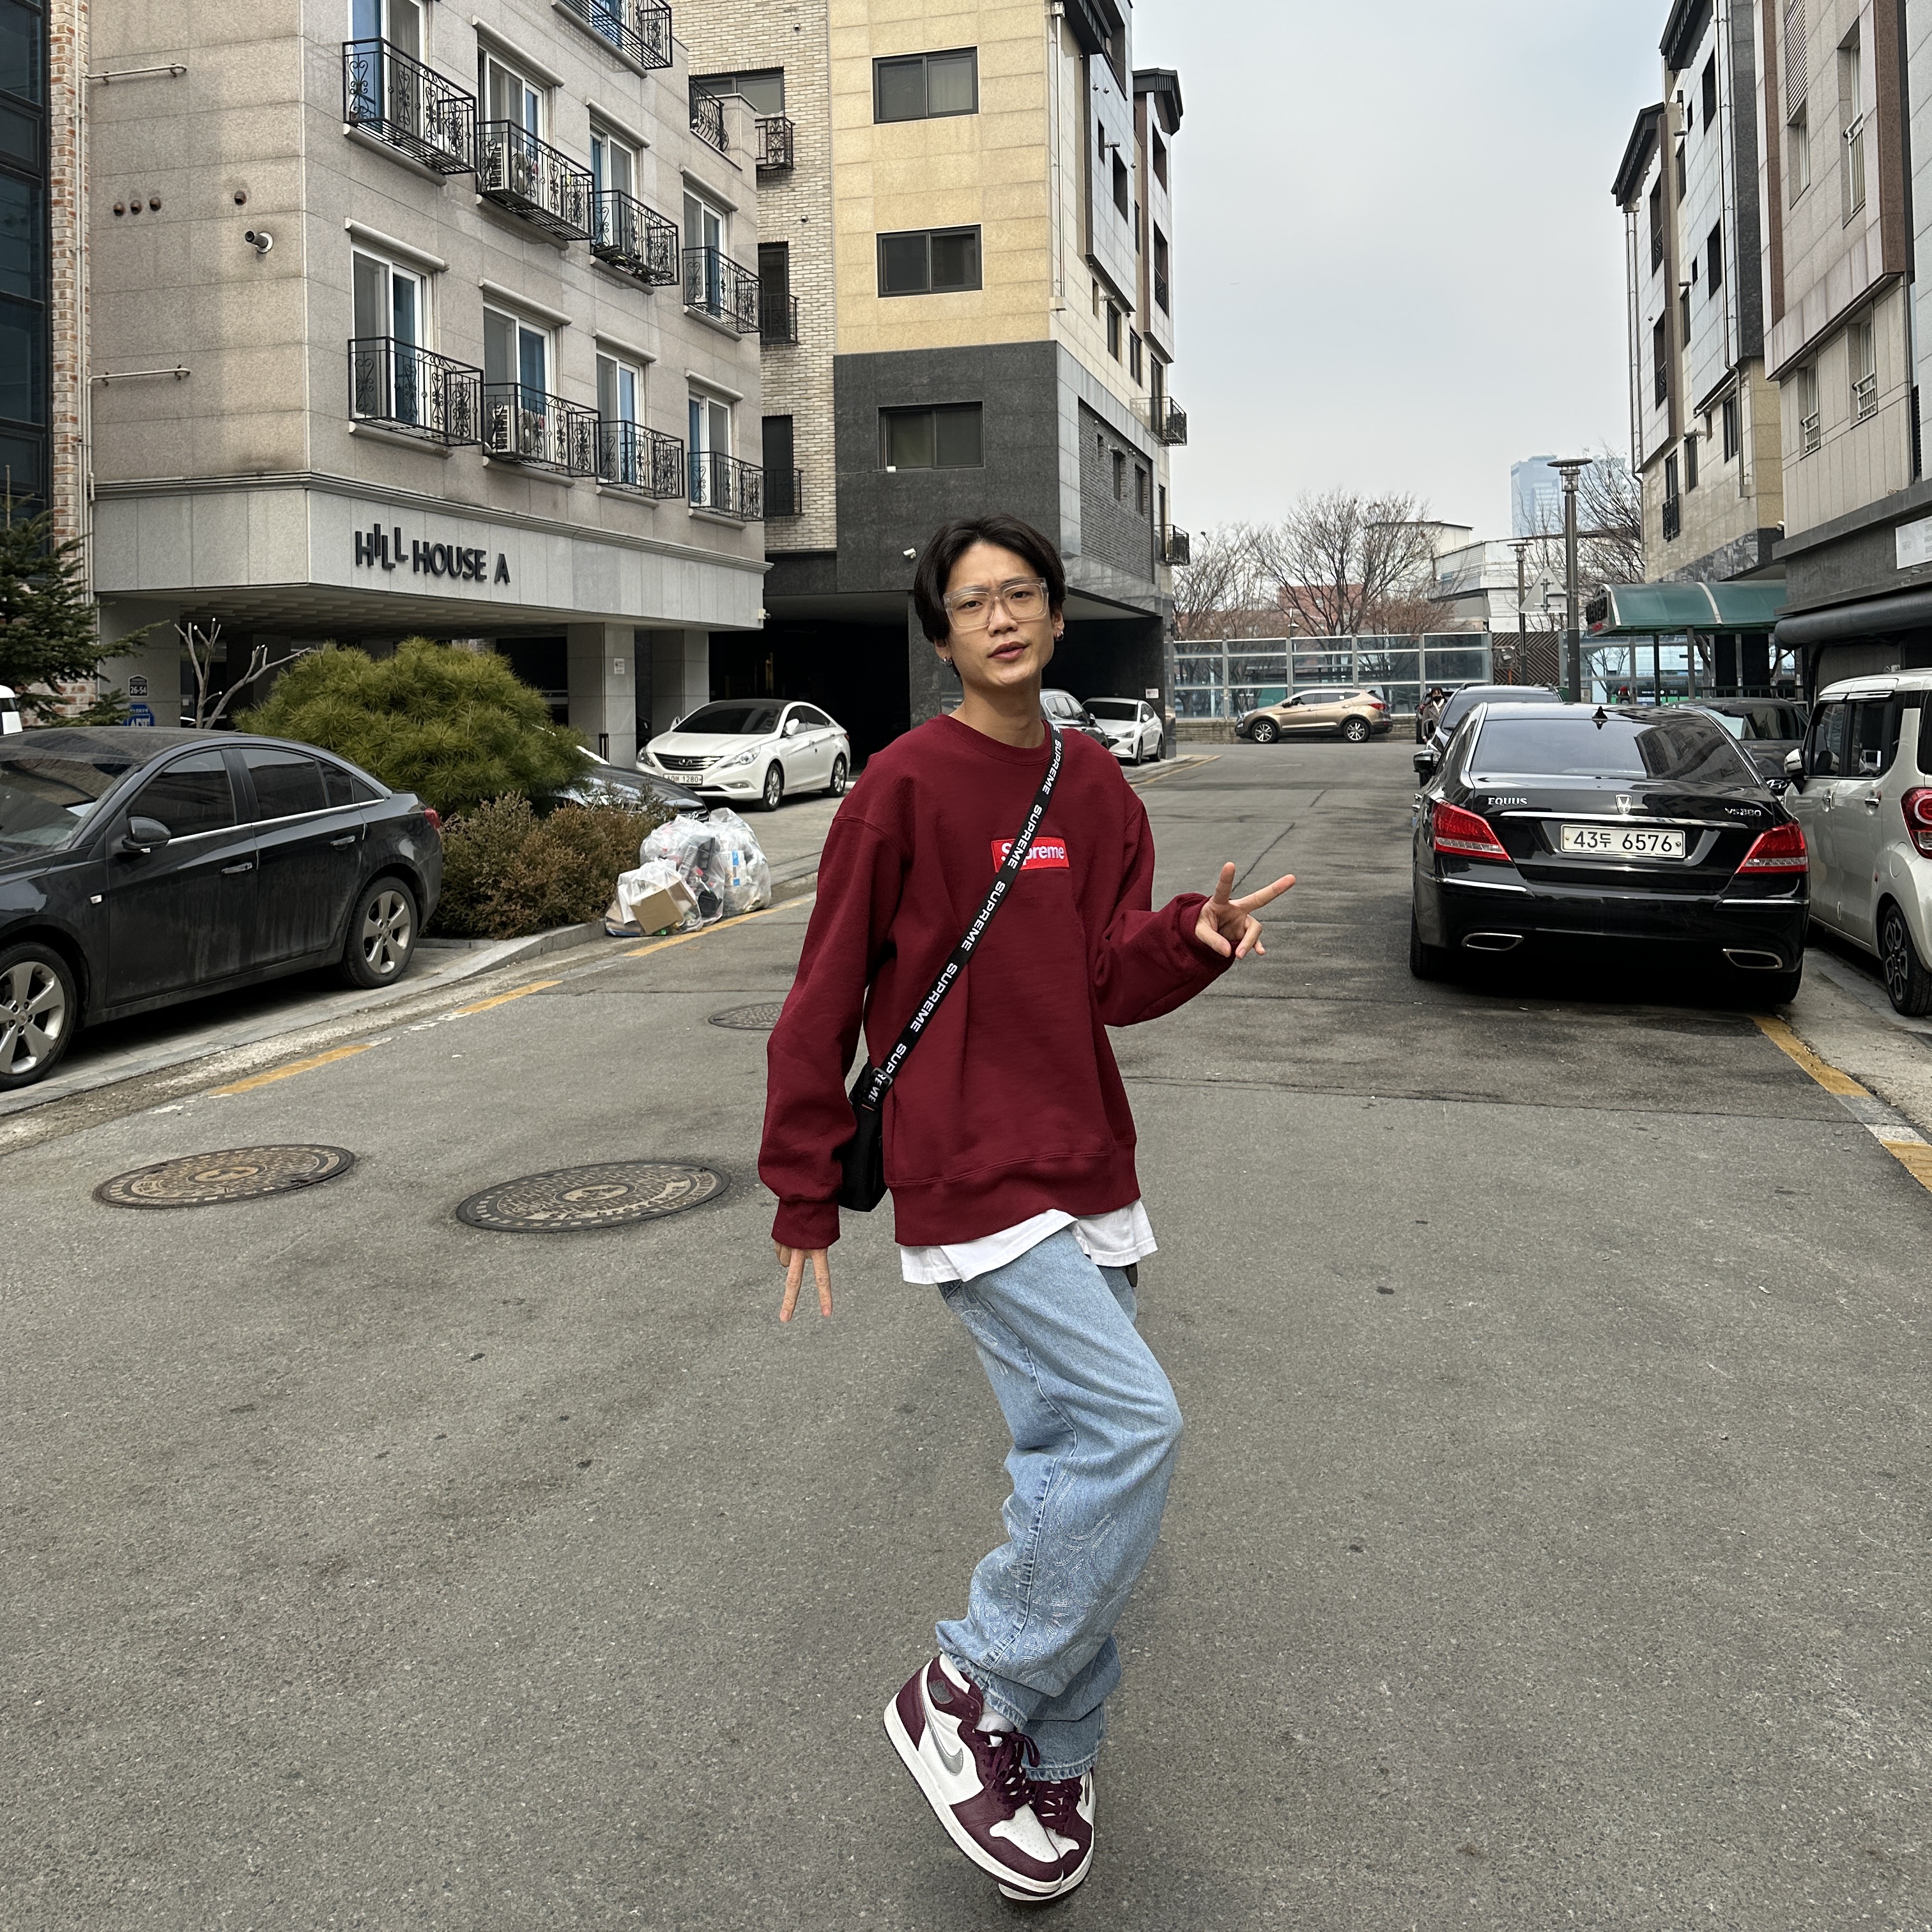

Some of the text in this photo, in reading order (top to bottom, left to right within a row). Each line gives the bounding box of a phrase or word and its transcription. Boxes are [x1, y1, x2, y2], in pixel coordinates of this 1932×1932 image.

[355, 523, 510, 584] HILL HOUSE A
[130, 686, 147, 694] 26-54
[1042, 739, 1062, 795] SUPREME
[1488, 797, 1528, 806] EQUUS
[1000, 841, 1065, 866] Spreme
[1007, 804, 1043, 870] SUPREME
[1573, 830, 1673, 853] 43두 6576
[961, 880, 1006, 951] SUPREME
[910, 963, 958, 1032] SUPREME
